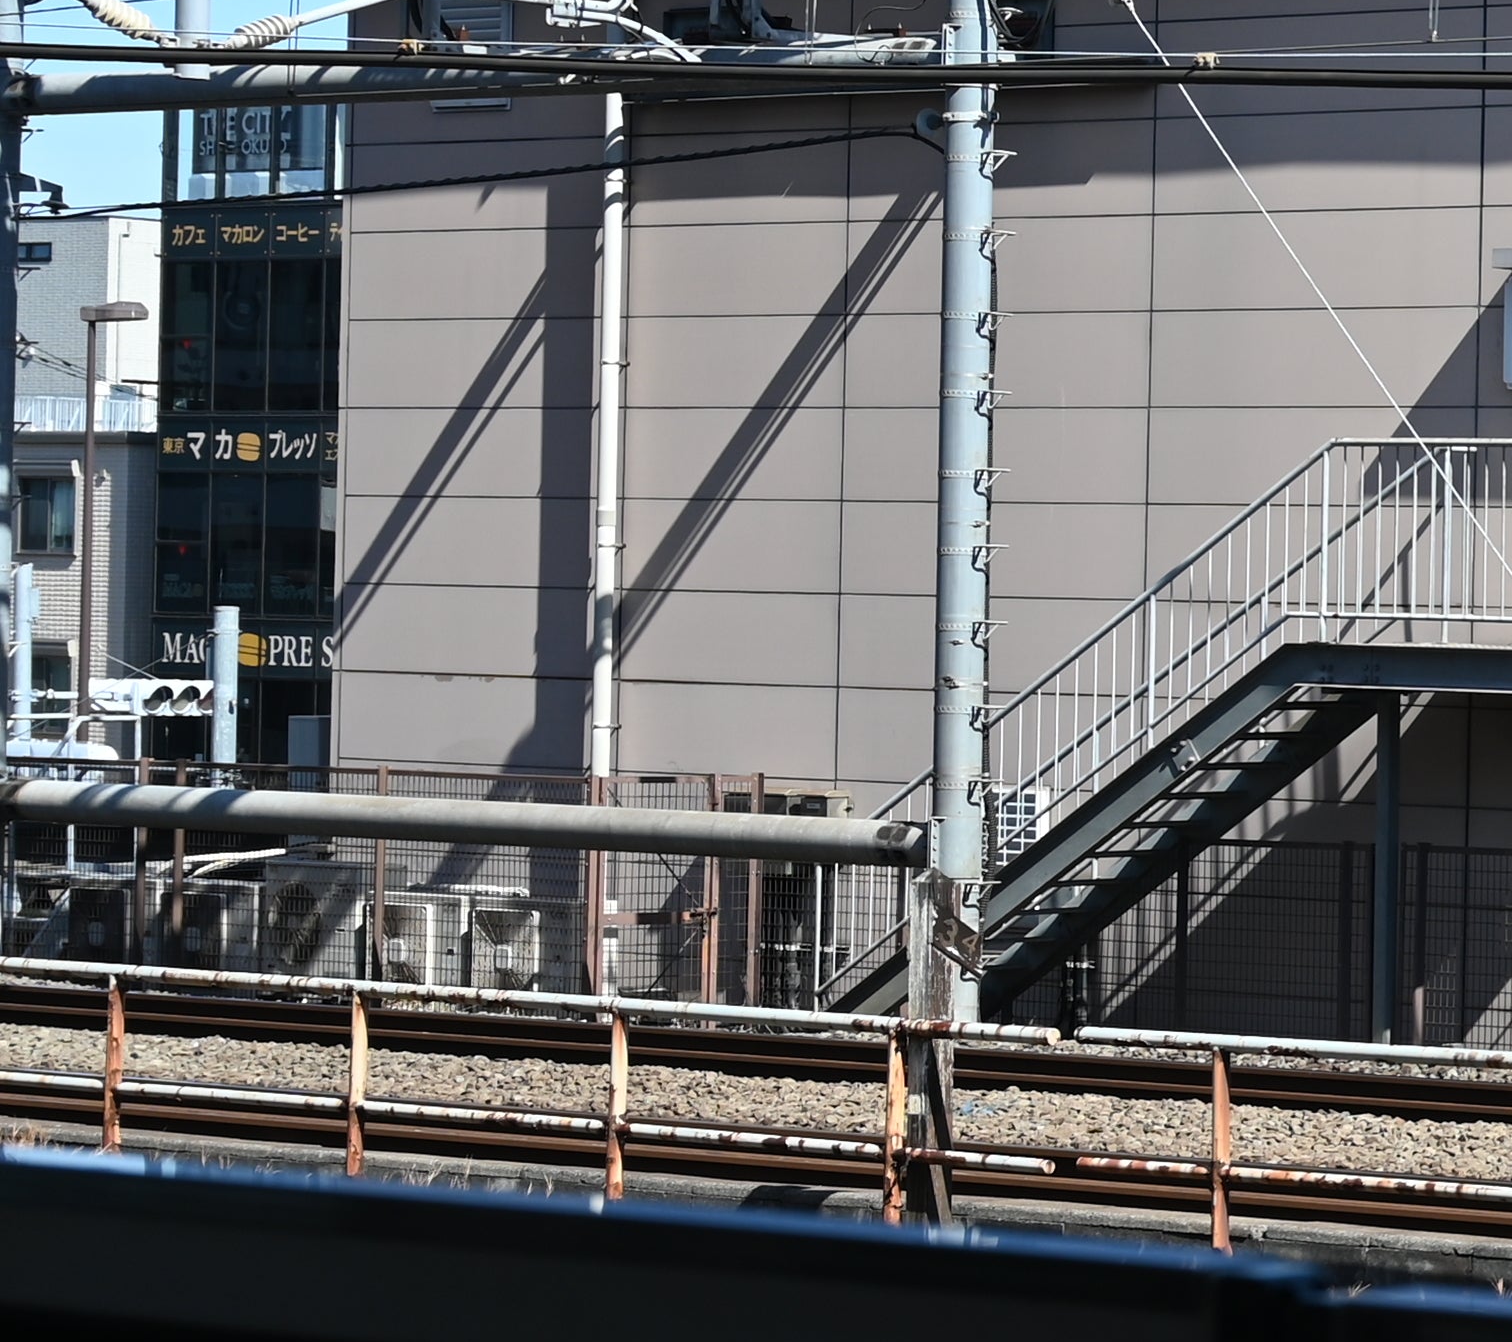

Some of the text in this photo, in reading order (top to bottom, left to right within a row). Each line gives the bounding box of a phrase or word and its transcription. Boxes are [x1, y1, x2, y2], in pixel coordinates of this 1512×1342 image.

[172, 224, 206, 246] カフェ
[220, 224, 265, 244] マカロン
[275, 223, 320, 242] コーヒー
[162, 437, 185, 454] 東京
